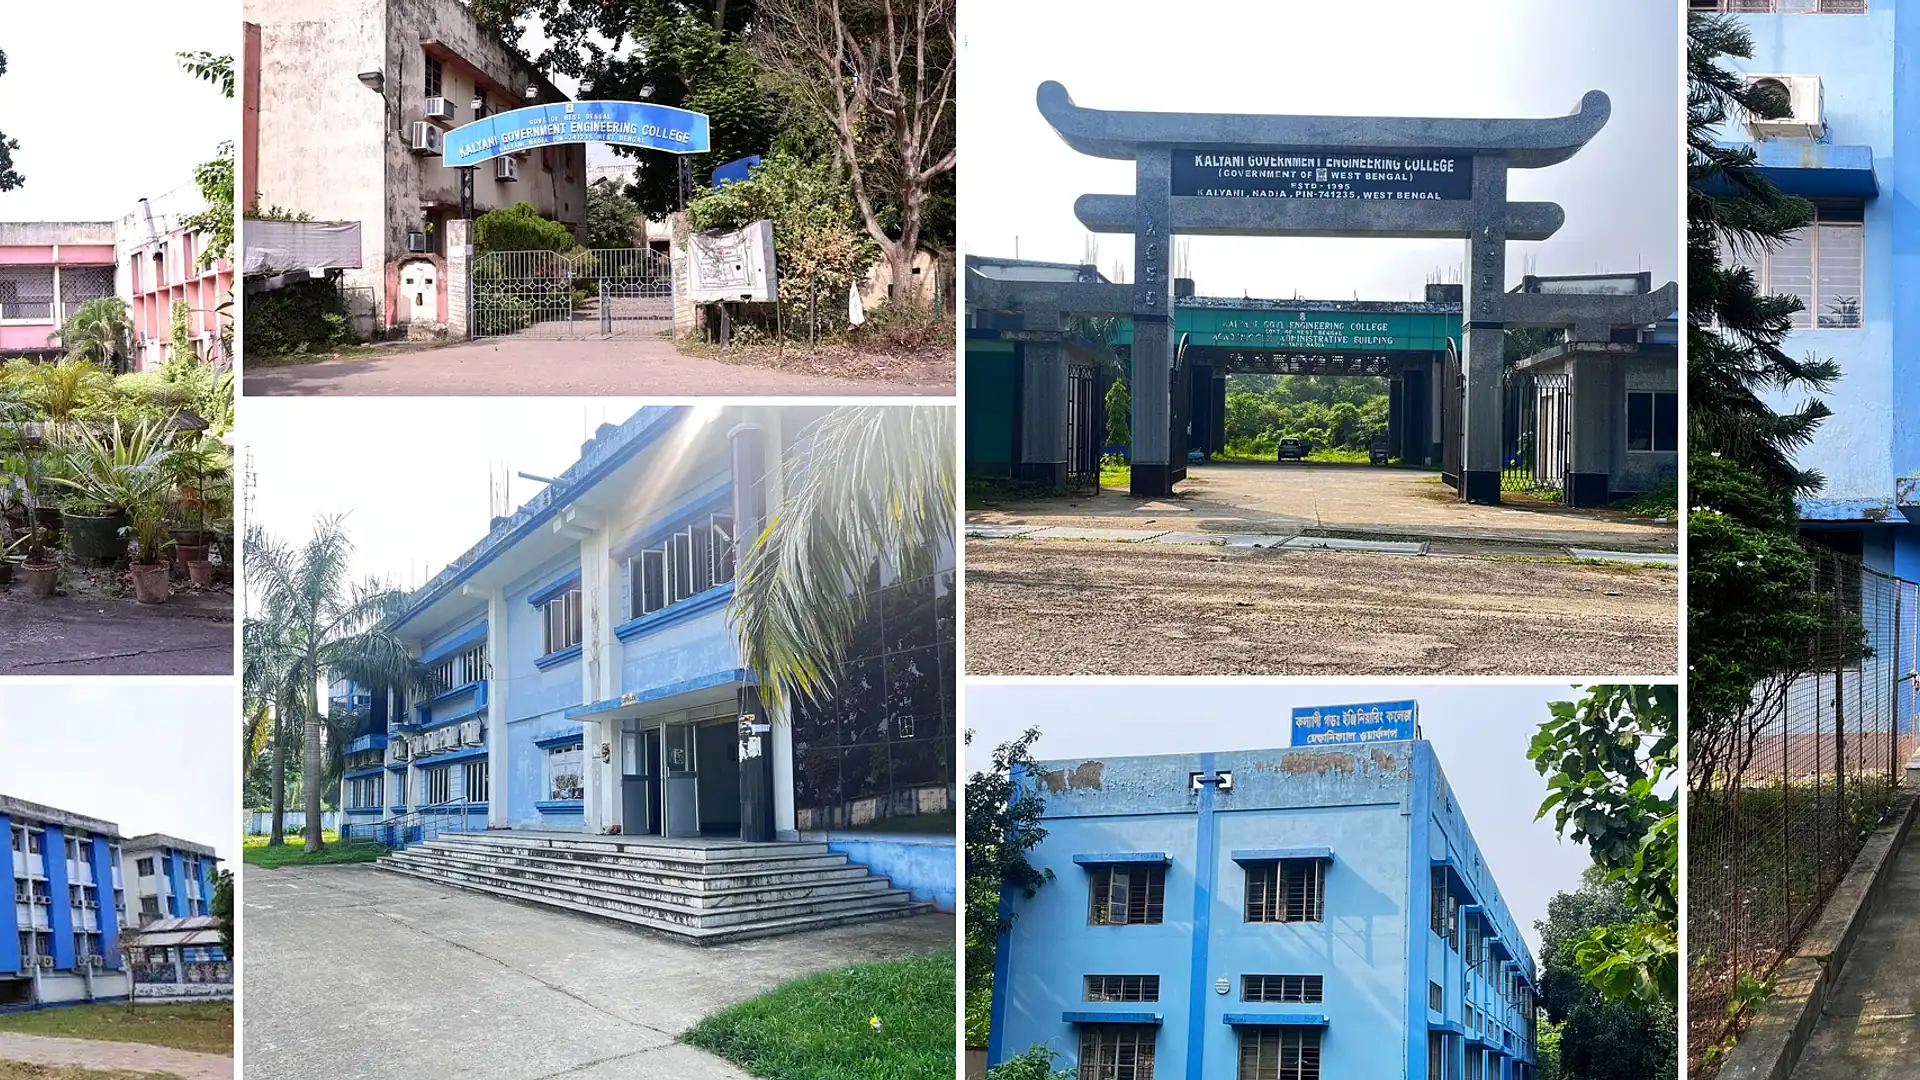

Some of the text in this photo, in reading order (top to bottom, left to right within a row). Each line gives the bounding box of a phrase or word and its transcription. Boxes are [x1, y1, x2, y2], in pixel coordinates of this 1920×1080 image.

[459, 121, 691, 158] KALYANI GOVERNMENT ENGINEERING COLLEGE
[1195, 155, 1454, 172] KALYANI GOVERNMENT ENGINEERING COLLEGE
[1218, 169, 1413, 182] (GOVERNMENT OF WEST BENGAL)
[1363, 191, 1393, 199] WEST
[1396, 192, 1441, 200] BENGAL
[1289, 321, 1345, 330] ENGINEERING
[1350, 322, 1389, 331] COLLEGE
[1279, 334, 1348, 344] ADMINISTRATIVE
[1354, 336, 1393, 345] BUILDING
